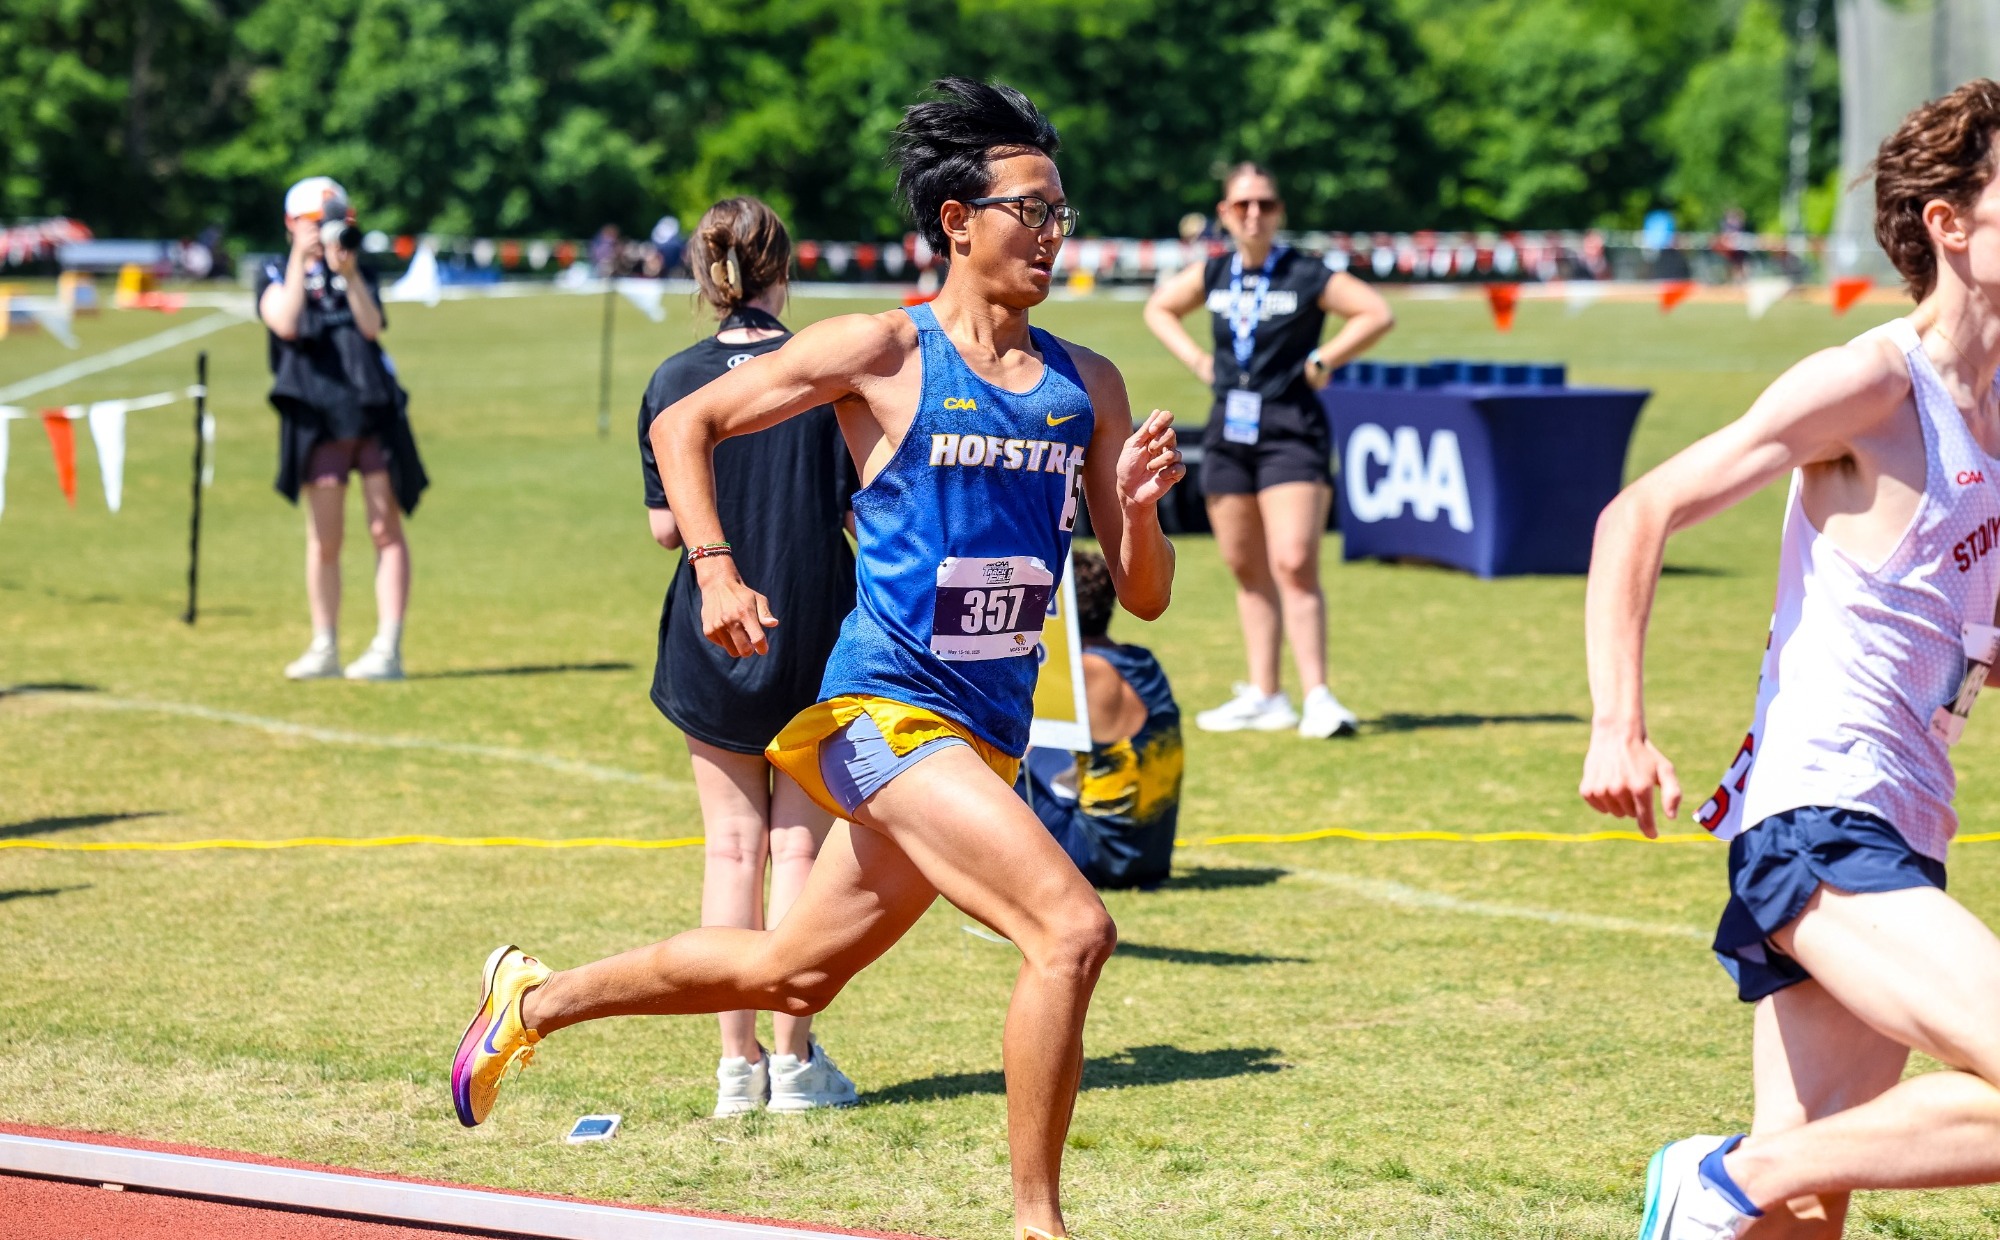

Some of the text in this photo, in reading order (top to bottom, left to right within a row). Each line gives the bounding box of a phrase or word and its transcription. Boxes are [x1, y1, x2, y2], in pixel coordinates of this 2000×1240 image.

[943, 397, 978, 411] CAA
[1346, 422, 1474, 534] CAA
[1956, 470, 1985, 485] CAA
[961, 587, 1026, 634] 357
